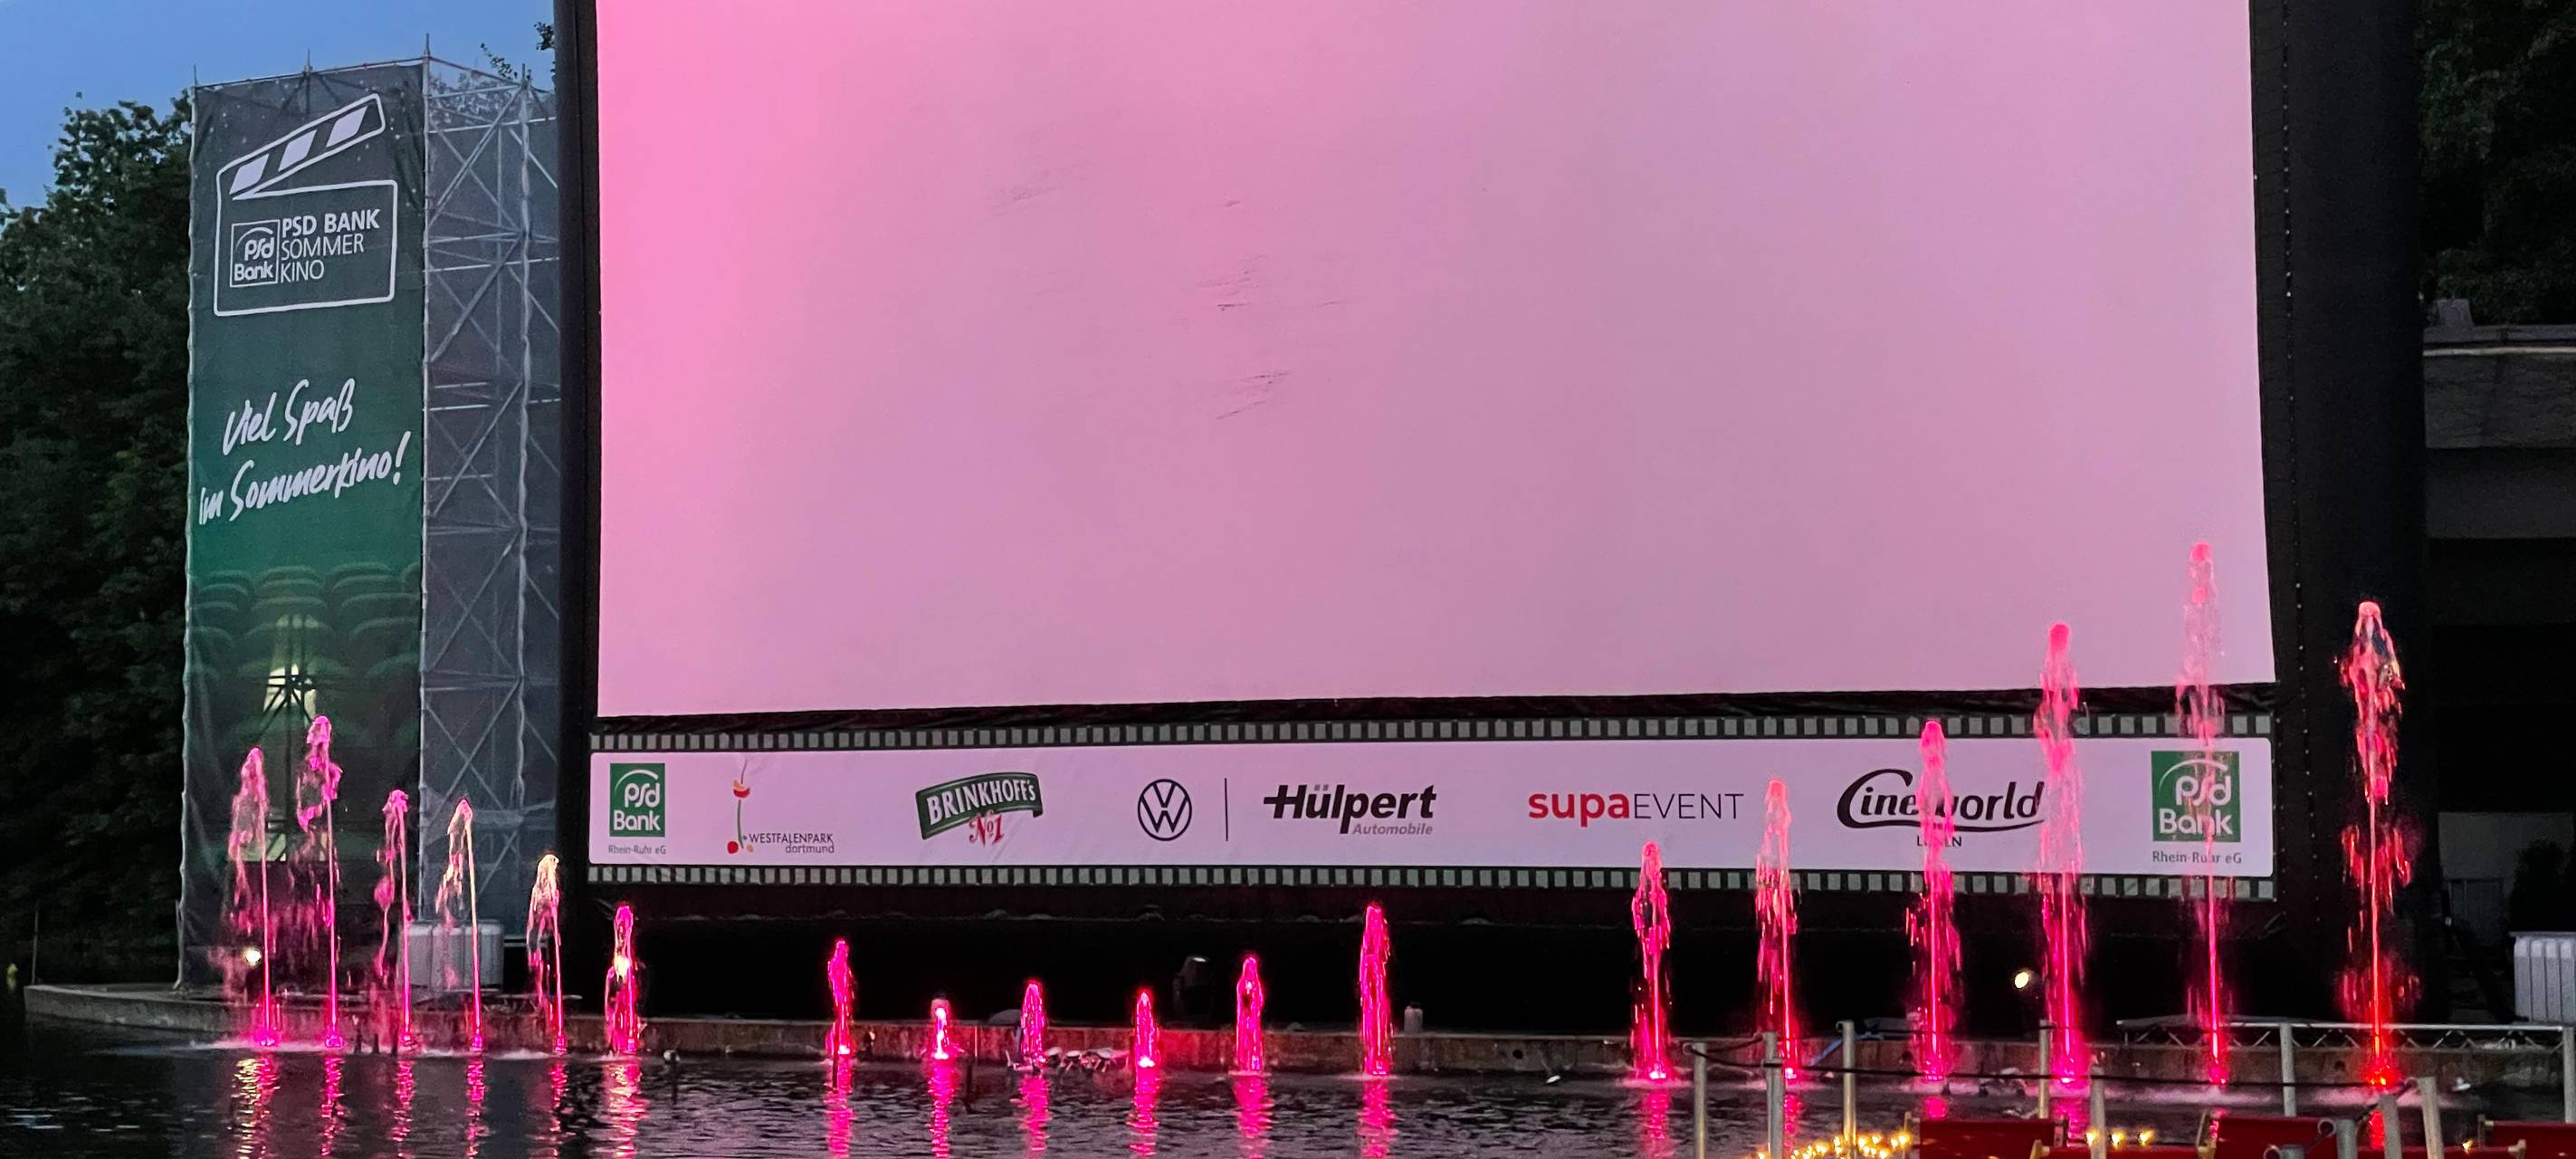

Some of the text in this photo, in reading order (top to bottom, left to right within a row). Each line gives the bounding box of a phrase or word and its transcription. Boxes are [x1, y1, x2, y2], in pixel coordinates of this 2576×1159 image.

[281, 209, 381, 238] PSD BANK
[243, 237, 275, 261] psd
[281, 234, 365, 261] SOMMER
[234, 261, 274, 282] Bank
[280, 259, 325, 283] KINO
[223, 378, 355, 455] Viel Spaß
[229, 430, 412, 522] Sommerkino!
[625, 782, 661, 808] psd
[2175, 775, 2232, 806] psd
[614, 809, 662, 831] Bank
[1264, 784, 1436, 834] Hülpert
[1528, 793, 1745, 828] supaEVENT
[2159, 808, 2234, 835] Bank
[749, 833, 834, 844] WESTFALENPARK
[1352, 823, 1434, 835] Automobile
[785, 843, 835, 854] dortmund
[2225, 852, 2242, 864] eG
